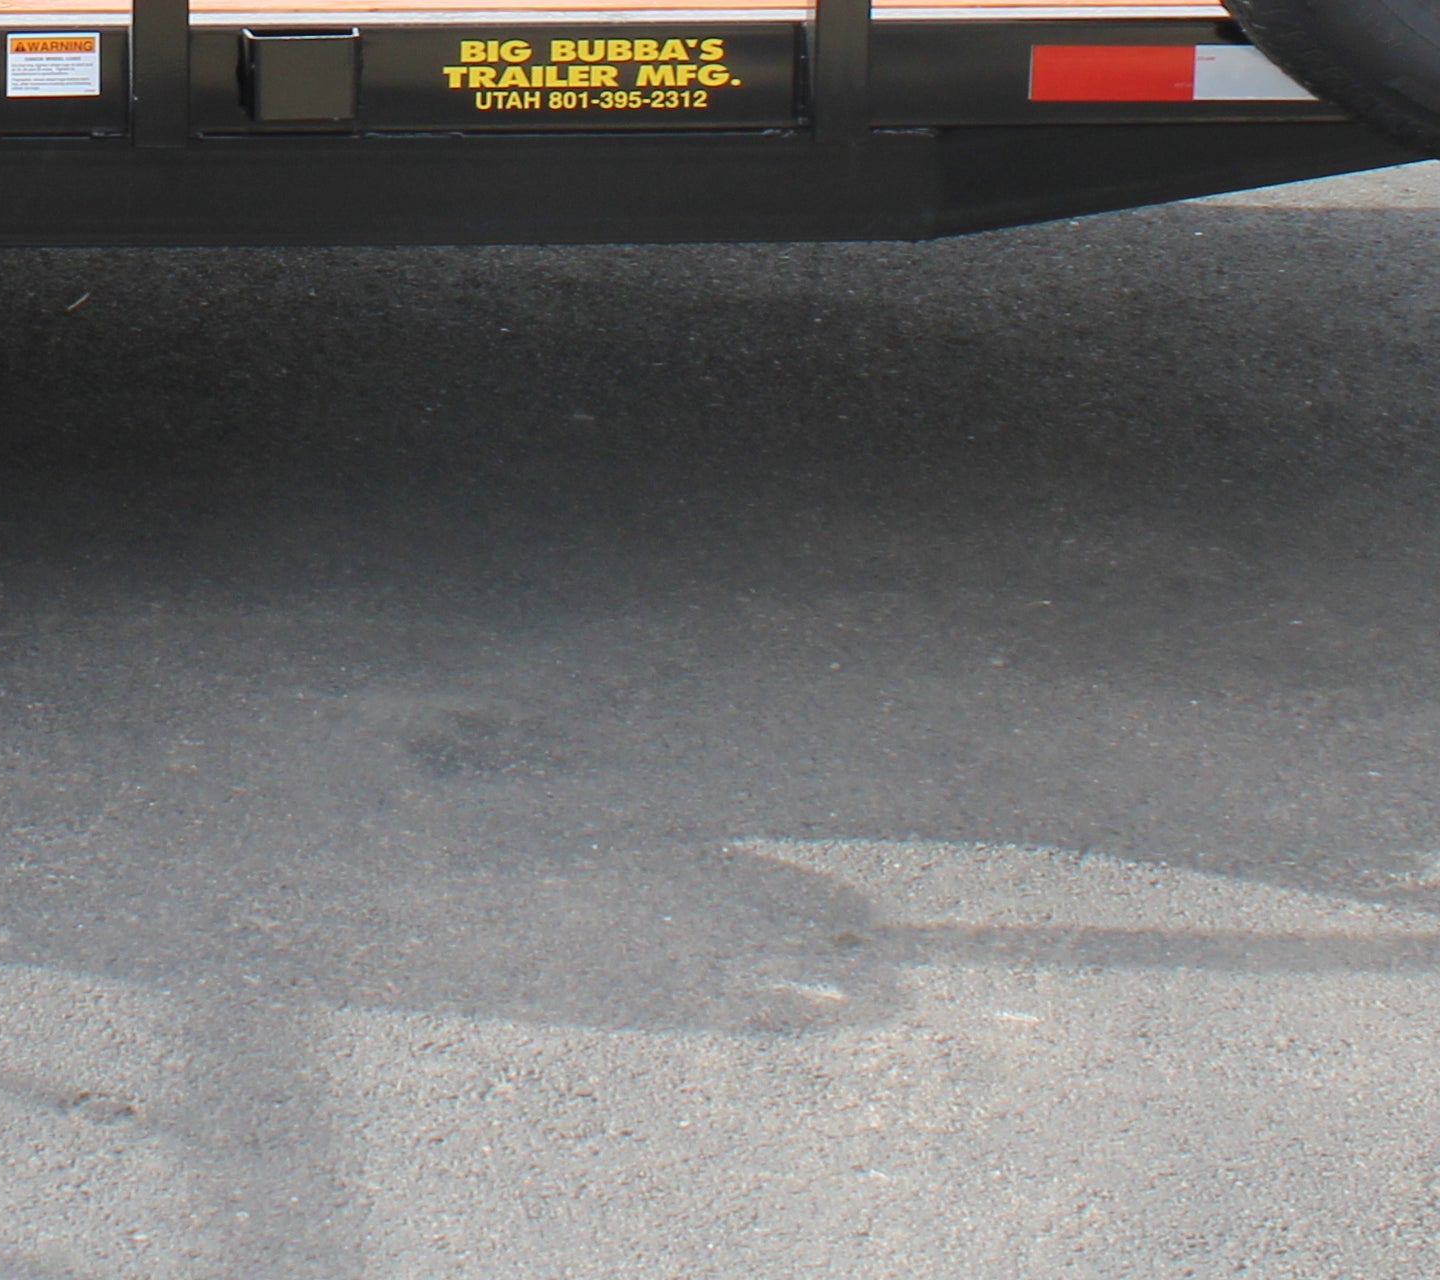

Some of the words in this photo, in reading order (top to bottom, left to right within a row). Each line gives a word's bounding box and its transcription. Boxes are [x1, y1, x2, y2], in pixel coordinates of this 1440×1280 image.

[27, 40, 94, 52] WARNING
[460, 40, 533, 63] BIG
[550, 38, 725, 63] BUBBA'S
[442, 65, 620, 89] TRAILER
[635, 63, 742, 87] MFG.
[475, 91, 542, 110] UTAH
[548, 90, 709, 110] 801-395-2312
